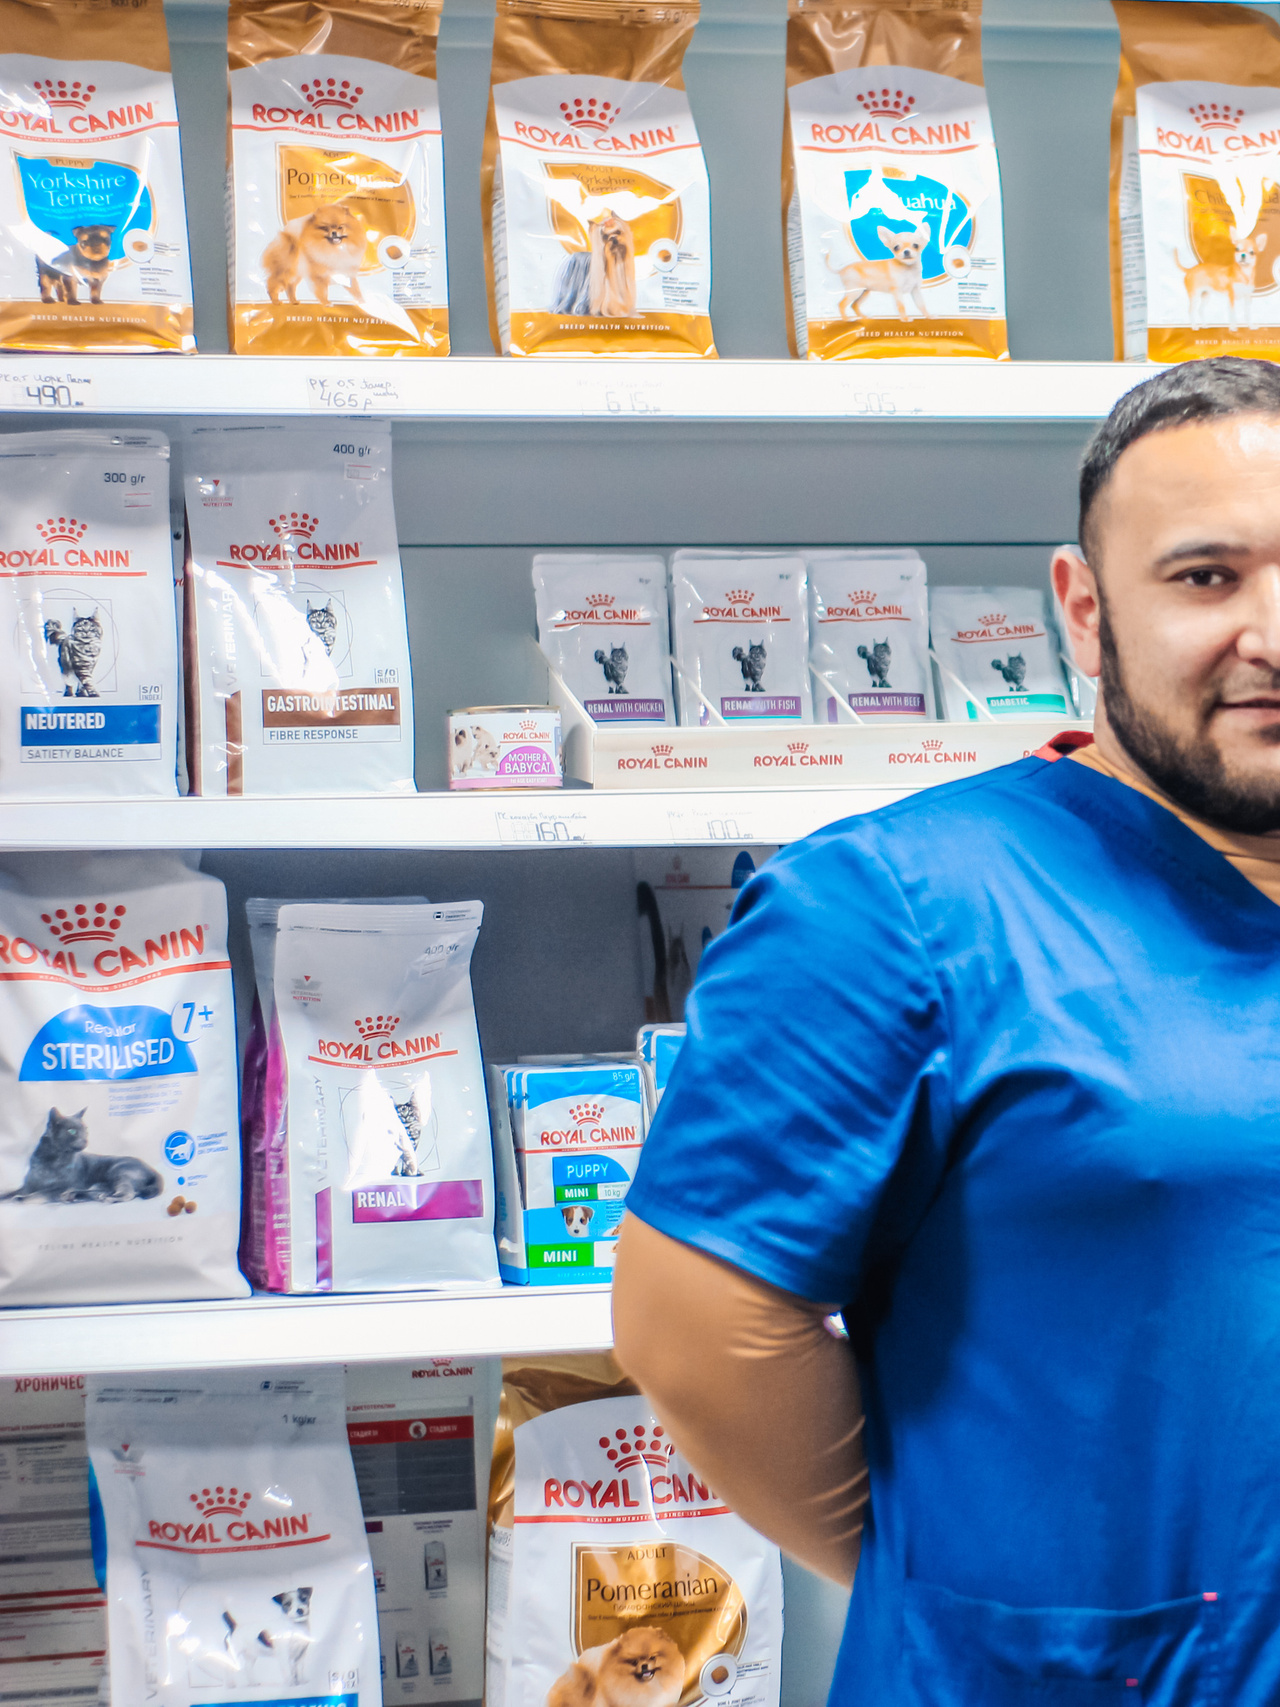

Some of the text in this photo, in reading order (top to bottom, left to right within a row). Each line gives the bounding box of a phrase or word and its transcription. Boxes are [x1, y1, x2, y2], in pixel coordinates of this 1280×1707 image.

[69, 102, 154, 133] CANIN
[252, 103, 419, 133] ROYAL CANIN
[514, 120, 675, 151] ROYAL CANIN
[811, 121, 970, 145] ROYAL CANIN
[1156, 126, 1219, 154] ROYAL
[55, 157, 85, 167] PUPPY
[27, 172, 127, 190] Yorkshire
[45, 189, 114, 207] Terrier
[61, 315, 95, 323] HEALTH
[99, 316, 147, 324] NUTRITION
[286, 315, 349, 324] BREED HEALTH
[559, 323, 671, 332] BREED HEALTH NUTRITION
[883, 330, 915, 338] HEALTH
[917, 330, 964, 338] NUTRITION
[320, 391, 358, 408] 465
[333, 444, 355, 456] 400
[104, 472, 127, 484] 300
[64, 549, 131, 567] CANIN
[229, 541, 361, 561] ROYAL CANIN
[564, 608, 641, 621] ROYAL CANIN
[702, 605, 782, 618] ROYAL CANIN
[826, 604, 903, 618] ROYAL CANIN
[957, 624, 1035, 640] ROYAL CANIN
[266, 693, 395, 713] GASTROINTESTINAL
[587, 702, 664, 714] RENAL WITH CHICKEN
[724, 699, 796, 711] RENAL WITH FISH
[852, 696, 922, 707] RENAL WITH BEEF
[990, 697, 1029, 707] DIABETIC
[26, 712, 106, 730] NEUTERED
[269, 728, 358, 741] FIBRE RESPONSE
[503, 732, 528, 740] ROYAL
[27, 747, 124, 759] SATIETY BALANCE
[508, 753, 541, 762] MOTHER
[888, 751, 977, 764] ROYAL CANIN
[504, 761, 551, 774] BABYCAT
[617, 756, 708, 770] ROYAL CANIN
[753, 754, 843, 768] ROYAL CANIN
[93, 924, 205, 978] CANIN
[425, 945, 443, 955] 400
[182, 1001, 214, 1034] 7+
[85, 1020, 136, 1038] Regular
[318, 1032, 441, 1061] ROYAL CANIN
[42, 1037, 175, 1071] STERILISED
[612, 1072, 623, 1081] 85
[314, 1074, 328, 1182] VETERINARY
[541, 1126, 635, 1145] ROYAL CANIN
[567, 1163, 609, 1178] PUPPY
[357, 1191, 405, 1208] RENAL
[565, 1187, 621, 1199] MINI 10 kg
[38, 1242, 76, 1250] FELINE
[127, 1235, 184, 1246] NUTRITION
[543, 1250, 577, 1263] MINI
[412, 1366, 473, 1379] ROYAL CANIN
[544, 1478, 640, 1508] ROYAL
[148, 1513, 309, 1544] ROYAL CANIN
[627, 1547, 667, 1561] ADULT
[587, 1573, 718, 1603] Pomeranian
